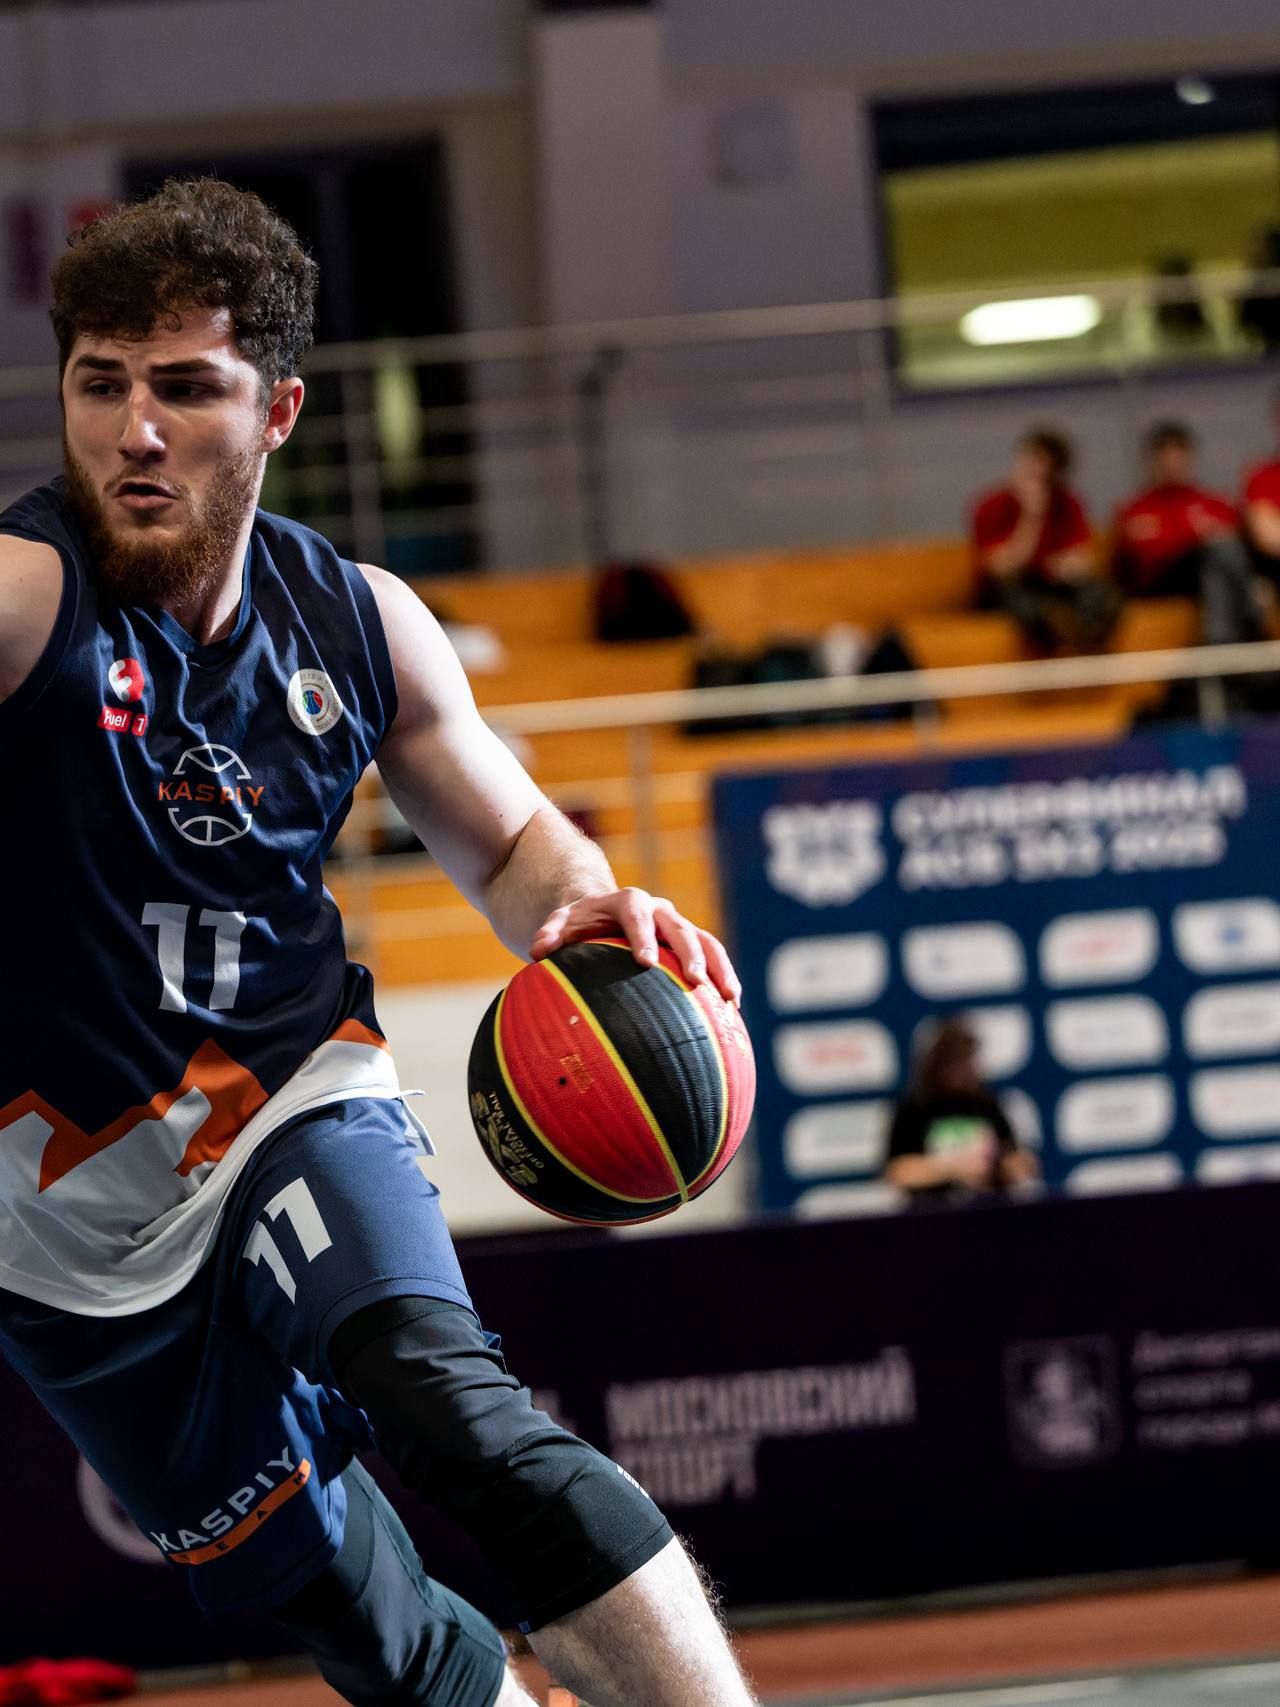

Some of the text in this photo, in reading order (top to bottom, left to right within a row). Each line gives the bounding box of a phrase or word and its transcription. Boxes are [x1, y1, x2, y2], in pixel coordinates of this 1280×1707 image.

[104, 709, 128, 728] Fuel
[158, 781, 266, 807] KASPIY
[141, 902, 246, 1014] 11
[242, 1176, 333, 1304] 11
[150, 1446, 295, 1551] KASPIY
